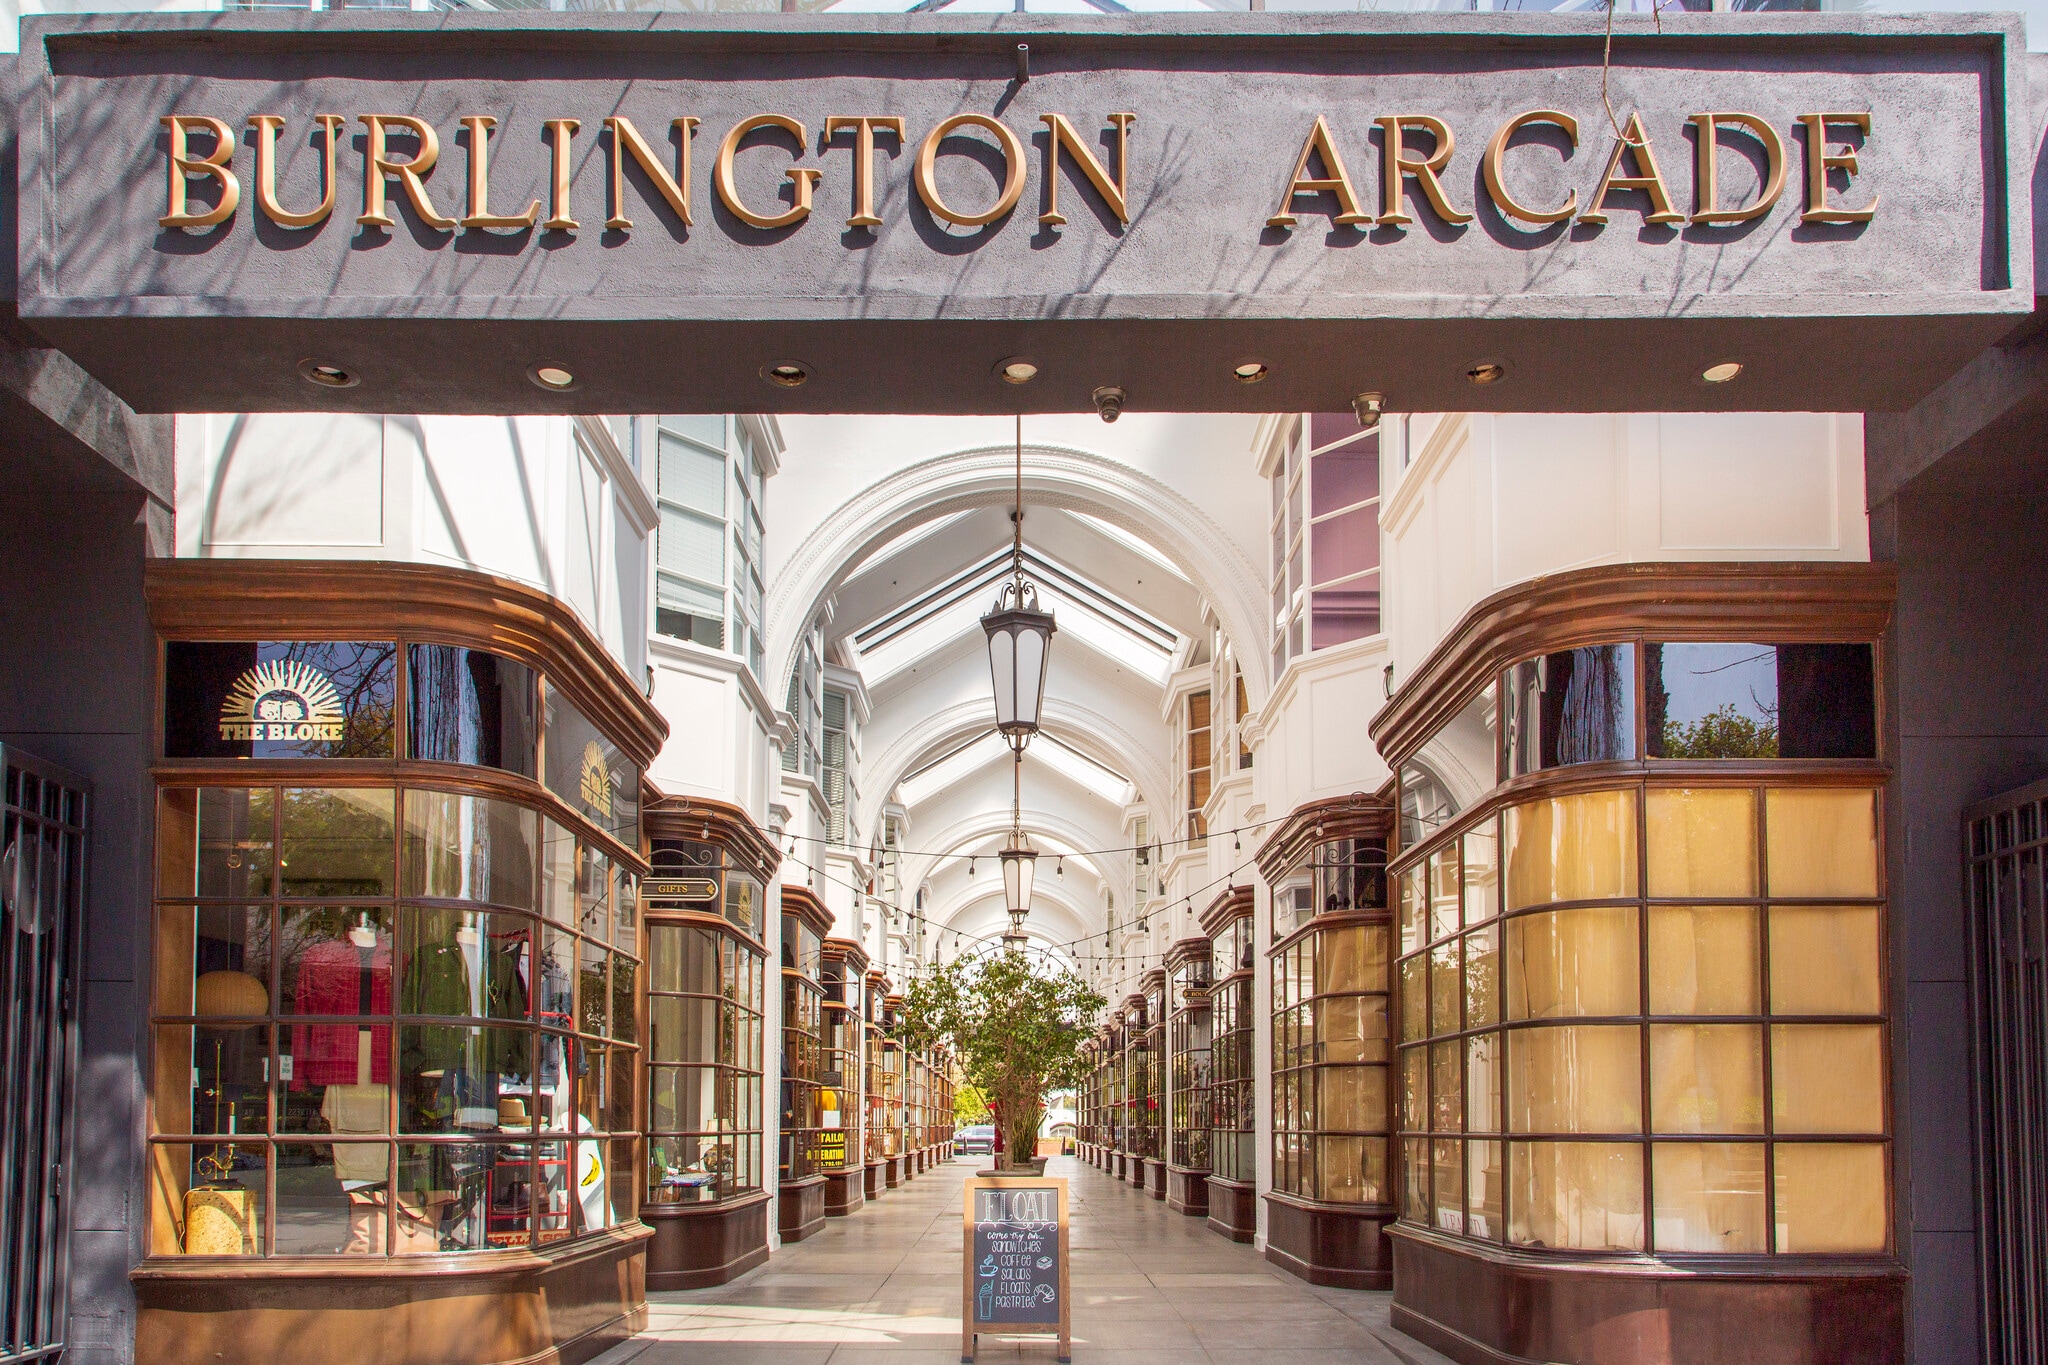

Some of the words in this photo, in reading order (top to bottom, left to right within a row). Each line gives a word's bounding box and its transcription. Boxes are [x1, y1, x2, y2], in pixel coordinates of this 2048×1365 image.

[158, 112, 1137, 229] BURLINGTON
[1265, 109, 1880, 225] ARCADE
[220, 724, 264, 740] THE
[267, 724, 343, 740] BLOKE
[658, 884, 688, 893] GIFTS
[982, 1191, 1051, 1222] FLOAT
